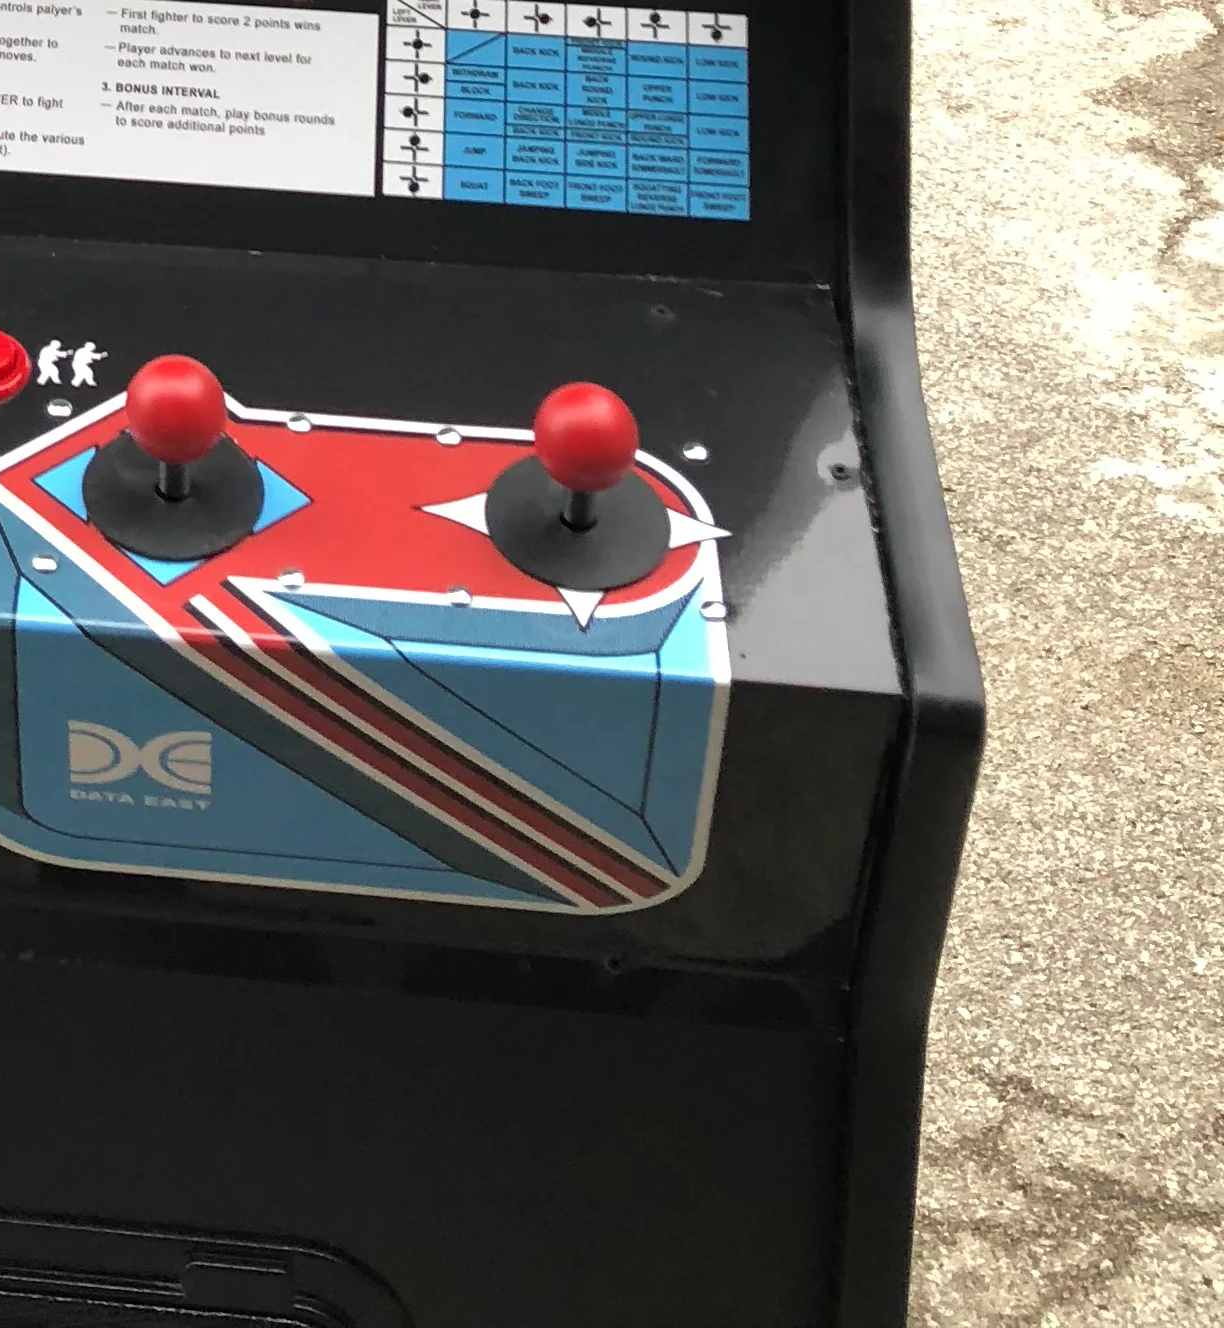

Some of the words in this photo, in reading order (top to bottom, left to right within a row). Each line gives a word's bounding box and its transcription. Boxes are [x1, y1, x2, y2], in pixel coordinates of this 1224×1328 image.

[121, 8, 147, 20] First
[151, 10, 189, 24] fighter
[192, 13, 204, 24] to
[207, 16, 240, 26] score
[243, 16, 251, 27] 2
[254, 19, 291, 30] points
[294, 22, 321, 31] wins
[47, 38, 58, 49] to
[118, 42, 156, 57] Player
[159, 46, 216, 59] advances
[220, 49, 232, 60] to
[235, 51, 260, 62] next
[264, 52, 293, 63] level
[296, 53, 312, 65] for
[117, 58, 146, 69] each
[150, 60, 186, 71] match
[115, 82, 158, 95] BONUS
[161, 85, 220, 99] INTERVAL
[22, 96, 34, 107] to
[37, 96, 64, 110] fight
[116, 100, 145, 113] After
[148, 104, 178, 115] each
[225, 108, 250, 123] play
[254, 110, 290, 123] bonus
[294, 114, 335, 126] rounds
[115, 116, 128, 127] to
[130, 118, 164, 129] score
[167, 119, 226, 133] additional
[228, 124, 266, 136] points
[19, 131, 39, 143] the
[42, 134, 85, 146] various
[70, 789, 134, 805] DATA
[144, 795, 211, 810] EAST
